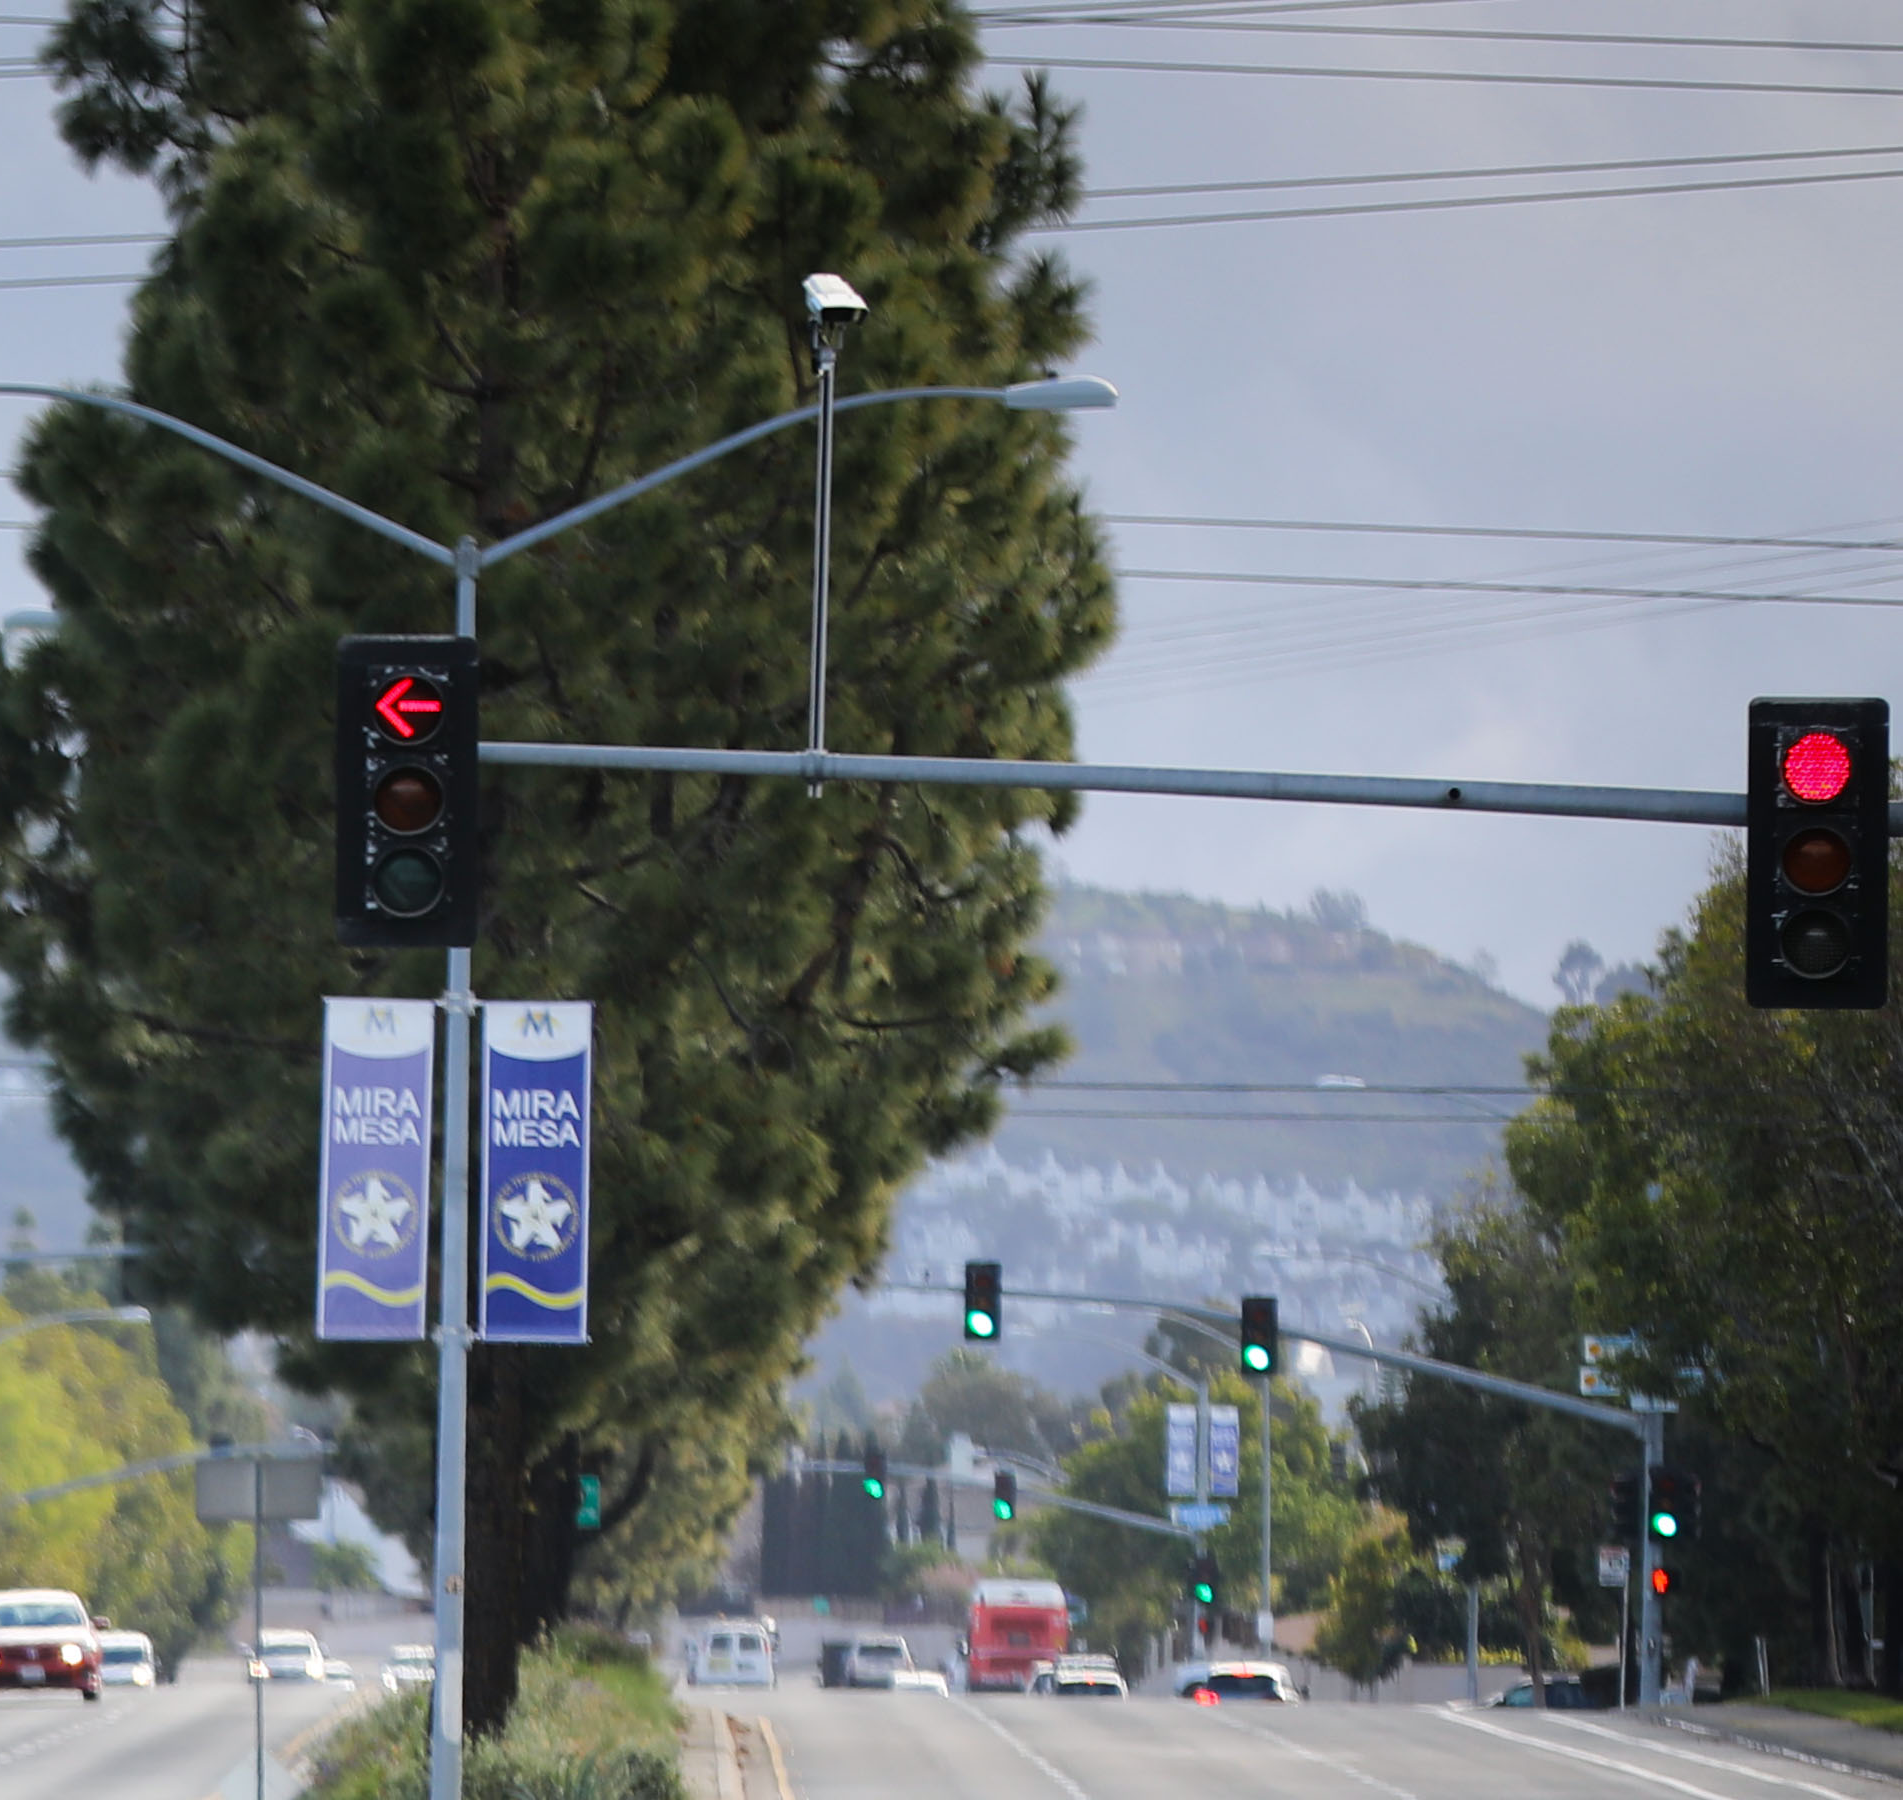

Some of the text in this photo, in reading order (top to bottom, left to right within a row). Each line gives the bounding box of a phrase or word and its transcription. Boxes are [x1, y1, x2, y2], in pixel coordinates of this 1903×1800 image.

[335, 1086, 421, 1119] MIRA
[494, 1088, 580, 1121] MIRA
[335, 1118, 420, 1146] MESA
[495, 1119, 580, 1148] MESA
